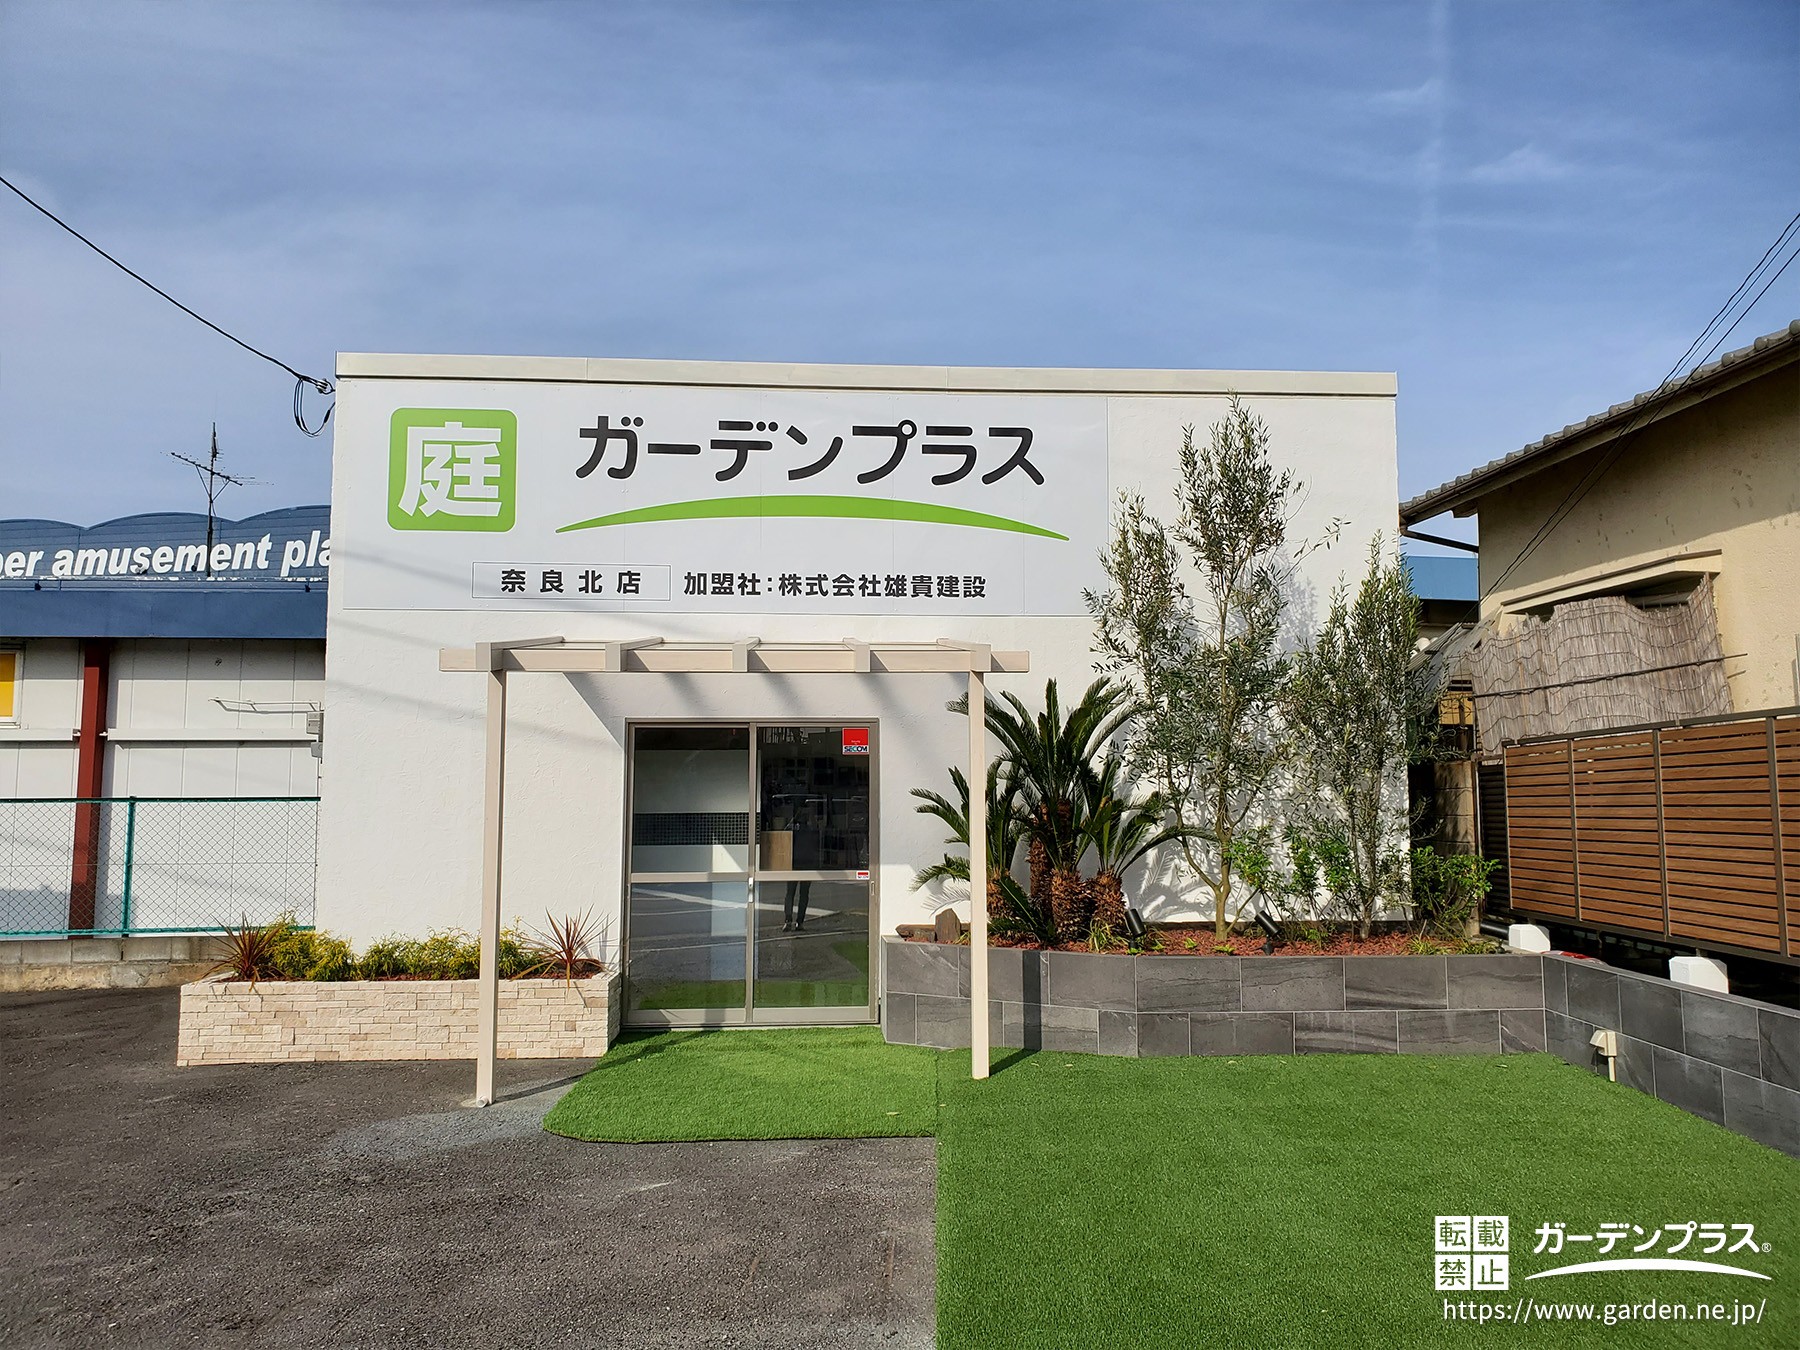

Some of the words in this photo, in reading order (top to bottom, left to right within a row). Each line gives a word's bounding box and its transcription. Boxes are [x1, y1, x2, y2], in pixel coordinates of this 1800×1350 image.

[398, 421, 502, 517] 庭
[575, 414, 1045, 487] ガーデンプラス
[0, 550, 45, 577] er
[52, 533, 272, 577] amusement
[500, 569, 641, 595] 奈良北店
